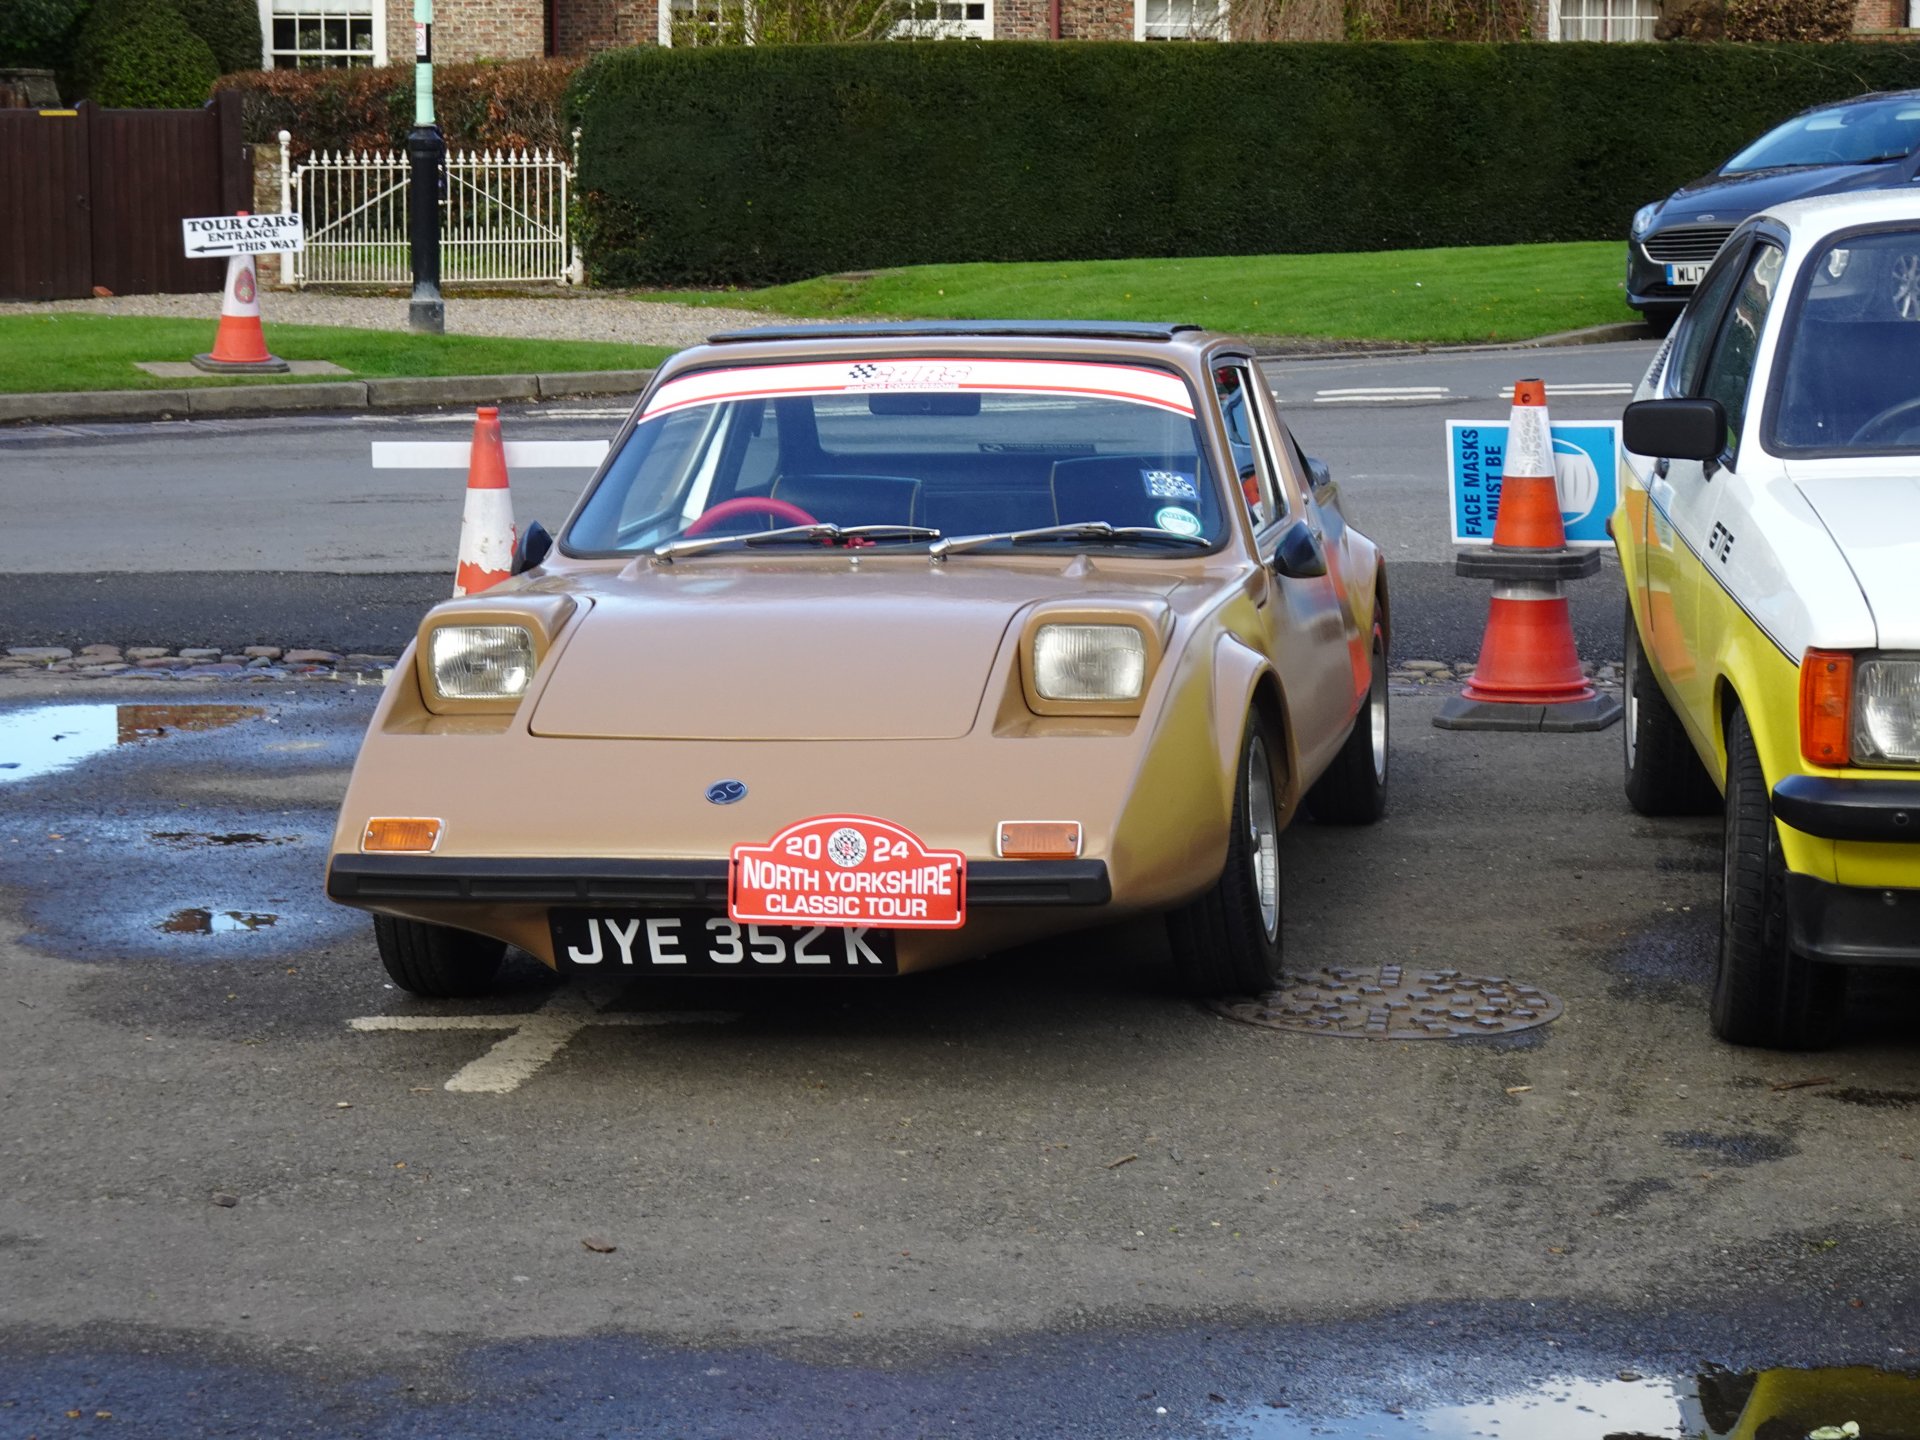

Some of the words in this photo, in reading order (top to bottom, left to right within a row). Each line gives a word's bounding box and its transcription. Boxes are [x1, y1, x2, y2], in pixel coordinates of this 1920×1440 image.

[188, 219, 242, 232] TOUR
[247, 215, 299, 229] CARS
[208, 228, 279, 242] ENTRANCE
[237, 240, 266, 252] THIS
[270, 239, 298, 249] WAY
[1462, 428, 1480, 488] MASKS
[1485, 446, 1501, 467] BE
[1464, 494, 1482, 536] FACE
[743, 856, 820, 892] NORTH
[825, 863, 952, 896] YORKSHIRE
[765, 894, 860, 915] CLASSIC
[865, 896, 928, 918] TOUR
[567, 918, 688, 965] JYE
